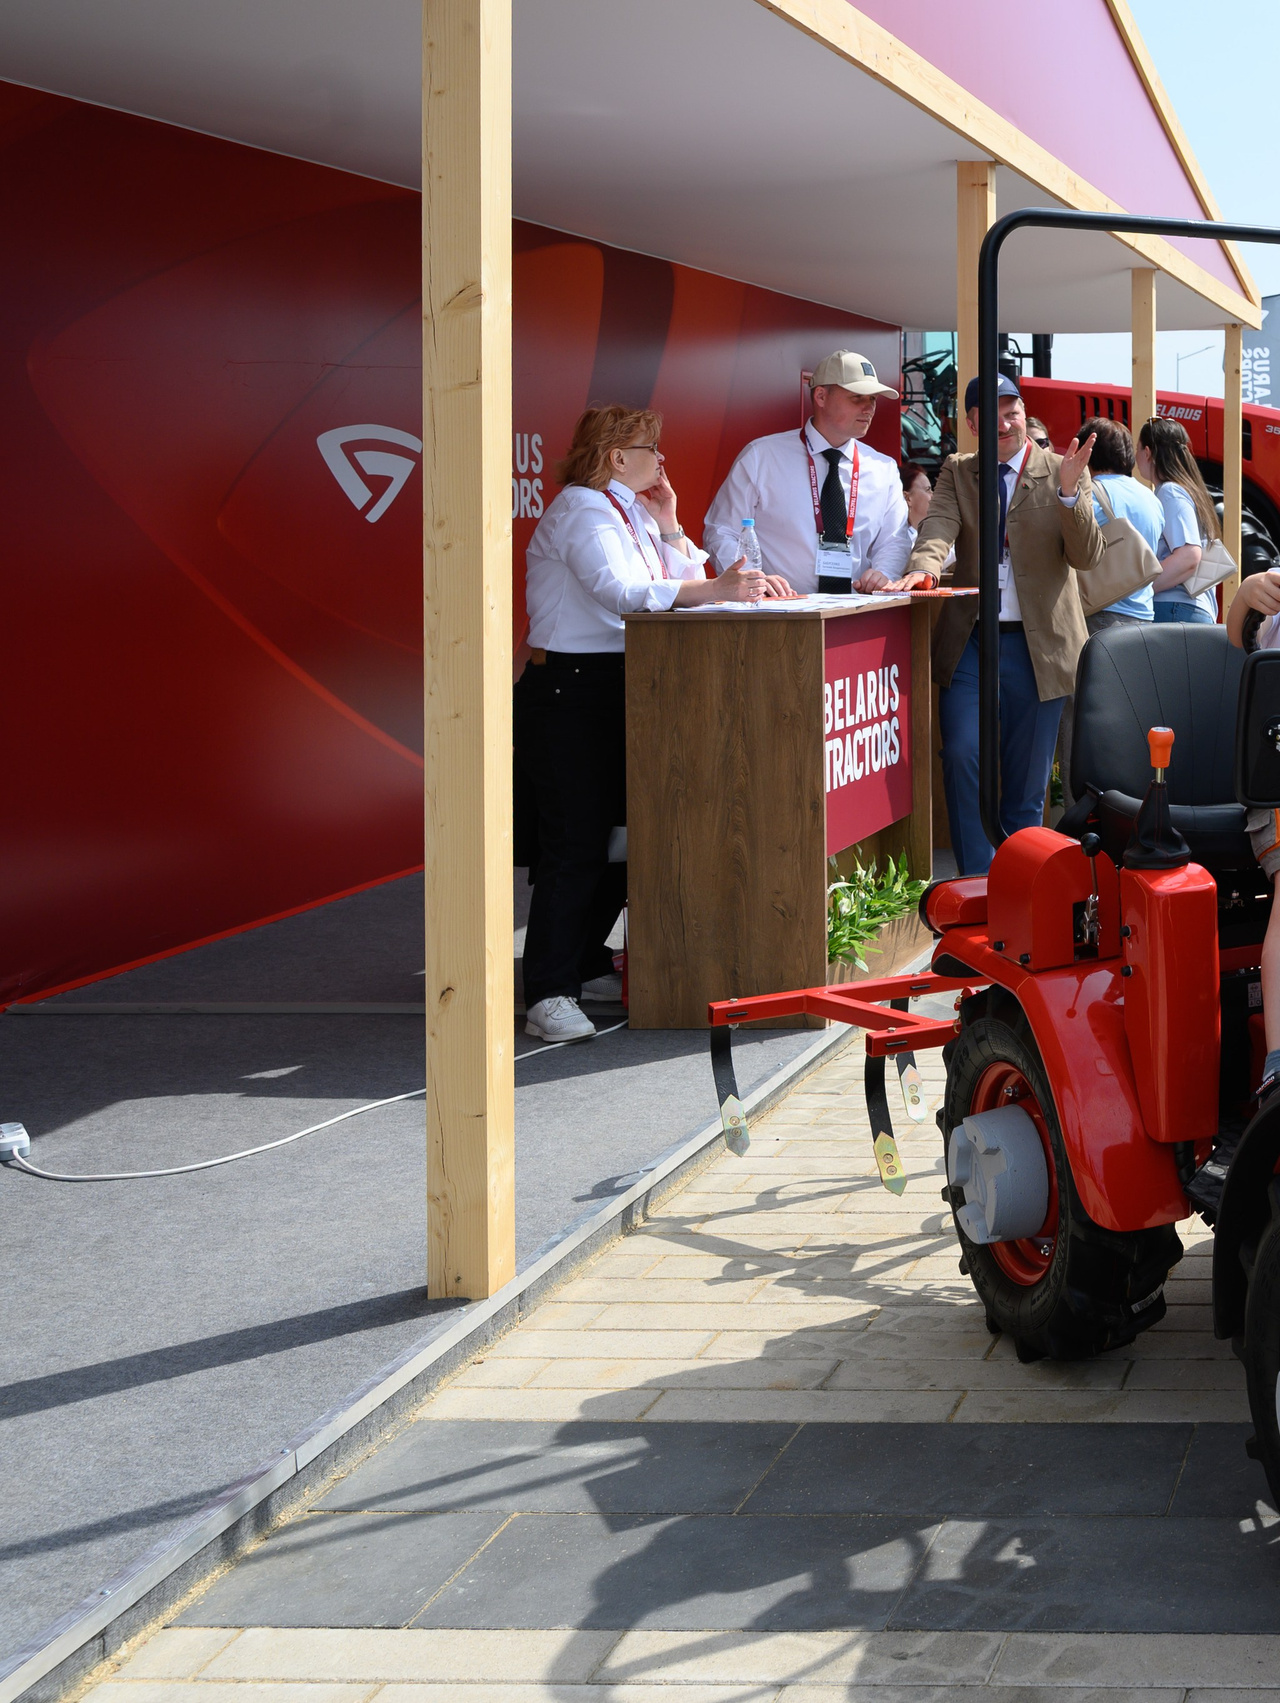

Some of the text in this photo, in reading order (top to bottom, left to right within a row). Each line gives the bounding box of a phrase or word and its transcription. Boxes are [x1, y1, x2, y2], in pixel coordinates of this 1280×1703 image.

[1156, 403, 1202, 422] ELARUS
[512, 432, 544, 474] US
[824, 664, 900, 734] BELARUS
[825, 716, 900, 793] TRACTORS
